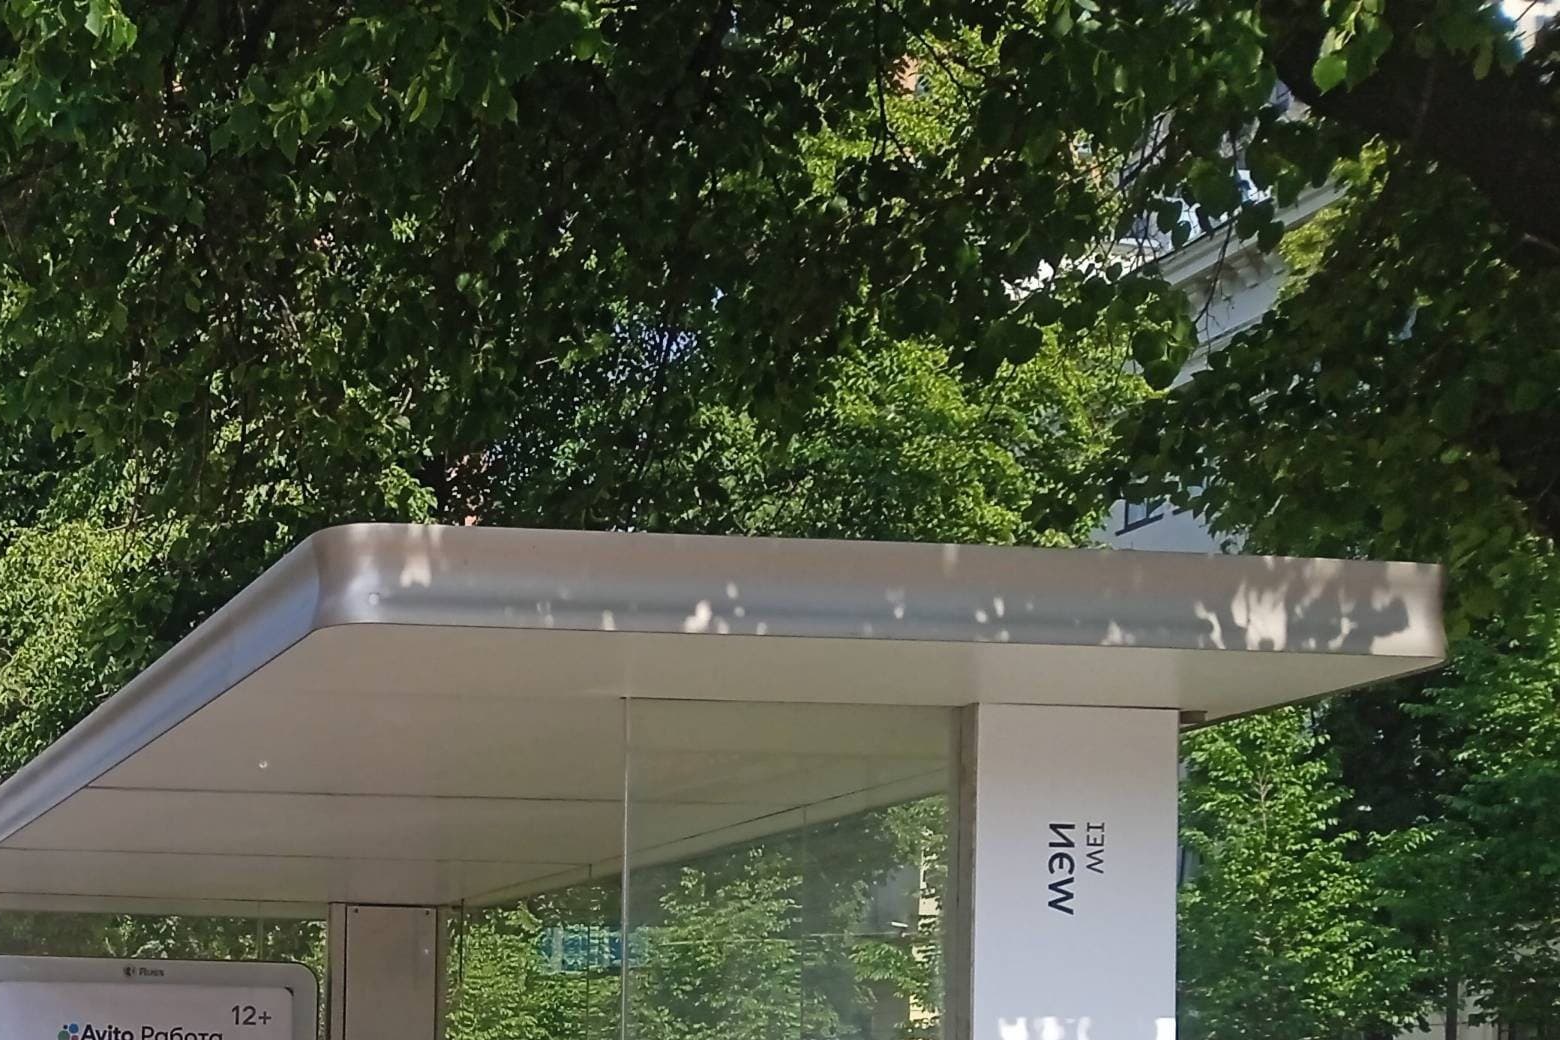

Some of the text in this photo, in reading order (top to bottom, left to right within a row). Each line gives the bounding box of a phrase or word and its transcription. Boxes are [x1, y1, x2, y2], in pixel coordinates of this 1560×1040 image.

[1048, 823, 1075, 915] МЭИ
[1086, 822, 1105, 874] MEI
[231, 1005, 272, 1026] 12+
